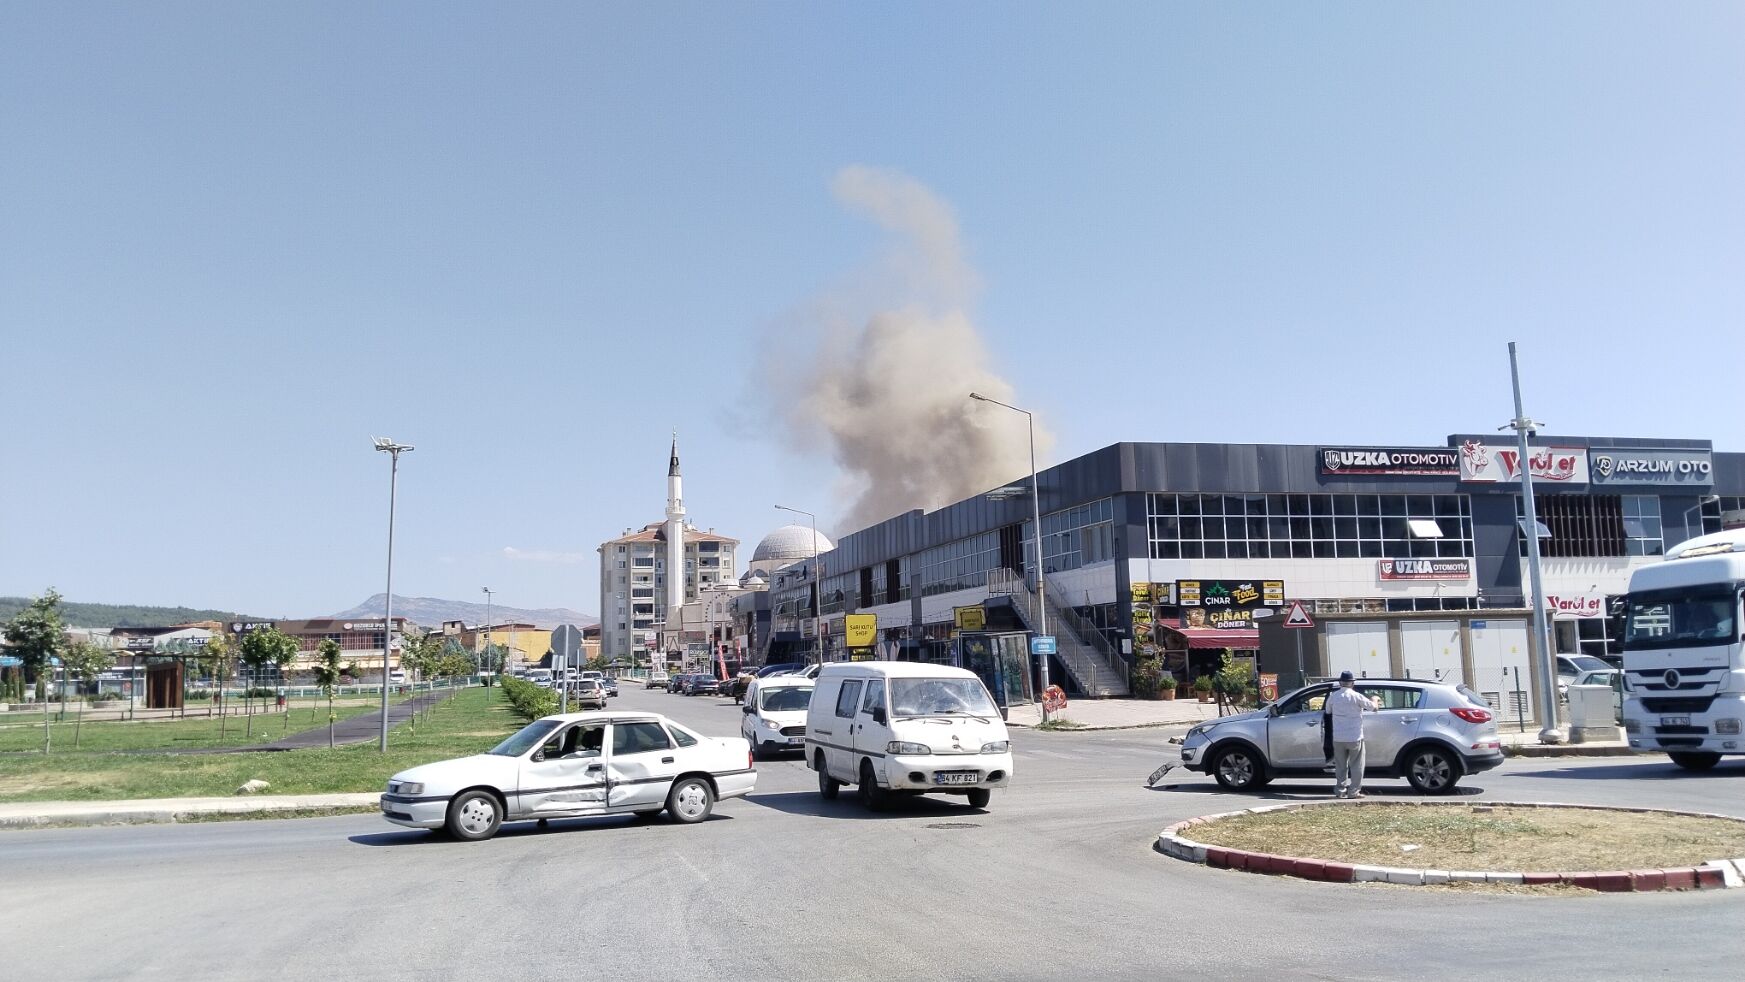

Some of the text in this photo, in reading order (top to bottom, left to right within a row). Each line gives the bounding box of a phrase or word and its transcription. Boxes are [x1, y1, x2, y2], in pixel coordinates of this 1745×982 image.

[1340, 451, 1391, 466] UZKA
[1616, 459, 1712, 474] ARZUM OTO
[1395, 560, 1434, 574] UZKA
[1205, 596, 1231, 606] ÇINAR
[1588, 597, 1600, 609] et
[1209, 610, 1251, 624] ÇINAR
